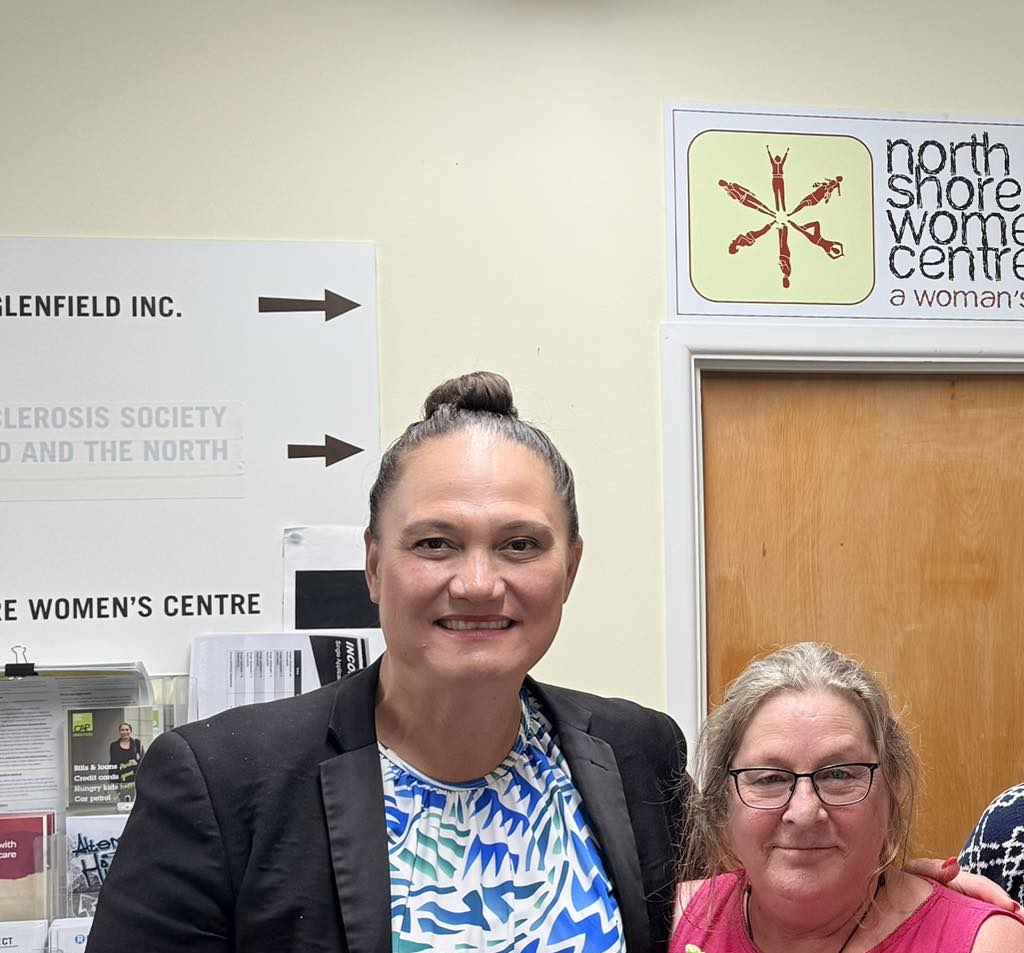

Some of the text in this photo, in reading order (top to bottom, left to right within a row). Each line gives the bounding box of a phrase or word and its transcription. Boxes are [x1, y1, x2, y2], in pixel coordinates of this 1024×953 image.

[886, 131, 1010, 176] north
[886, 164, 1022, 212] shore
[0, 295, 183, 317] LENFIELD INC.
[889, 288, 906, 307] a
[0, 406, 227, 429] LEROSIS SOCIETY
[21, 441, 74, 463] AND
[84, 440, 133, 462] THE
[143, 439, 229, 462] NORTH
[0, 592, 261, 621] E WOMEN'S CENTRE
[345, 641, 356, 674] INCO
